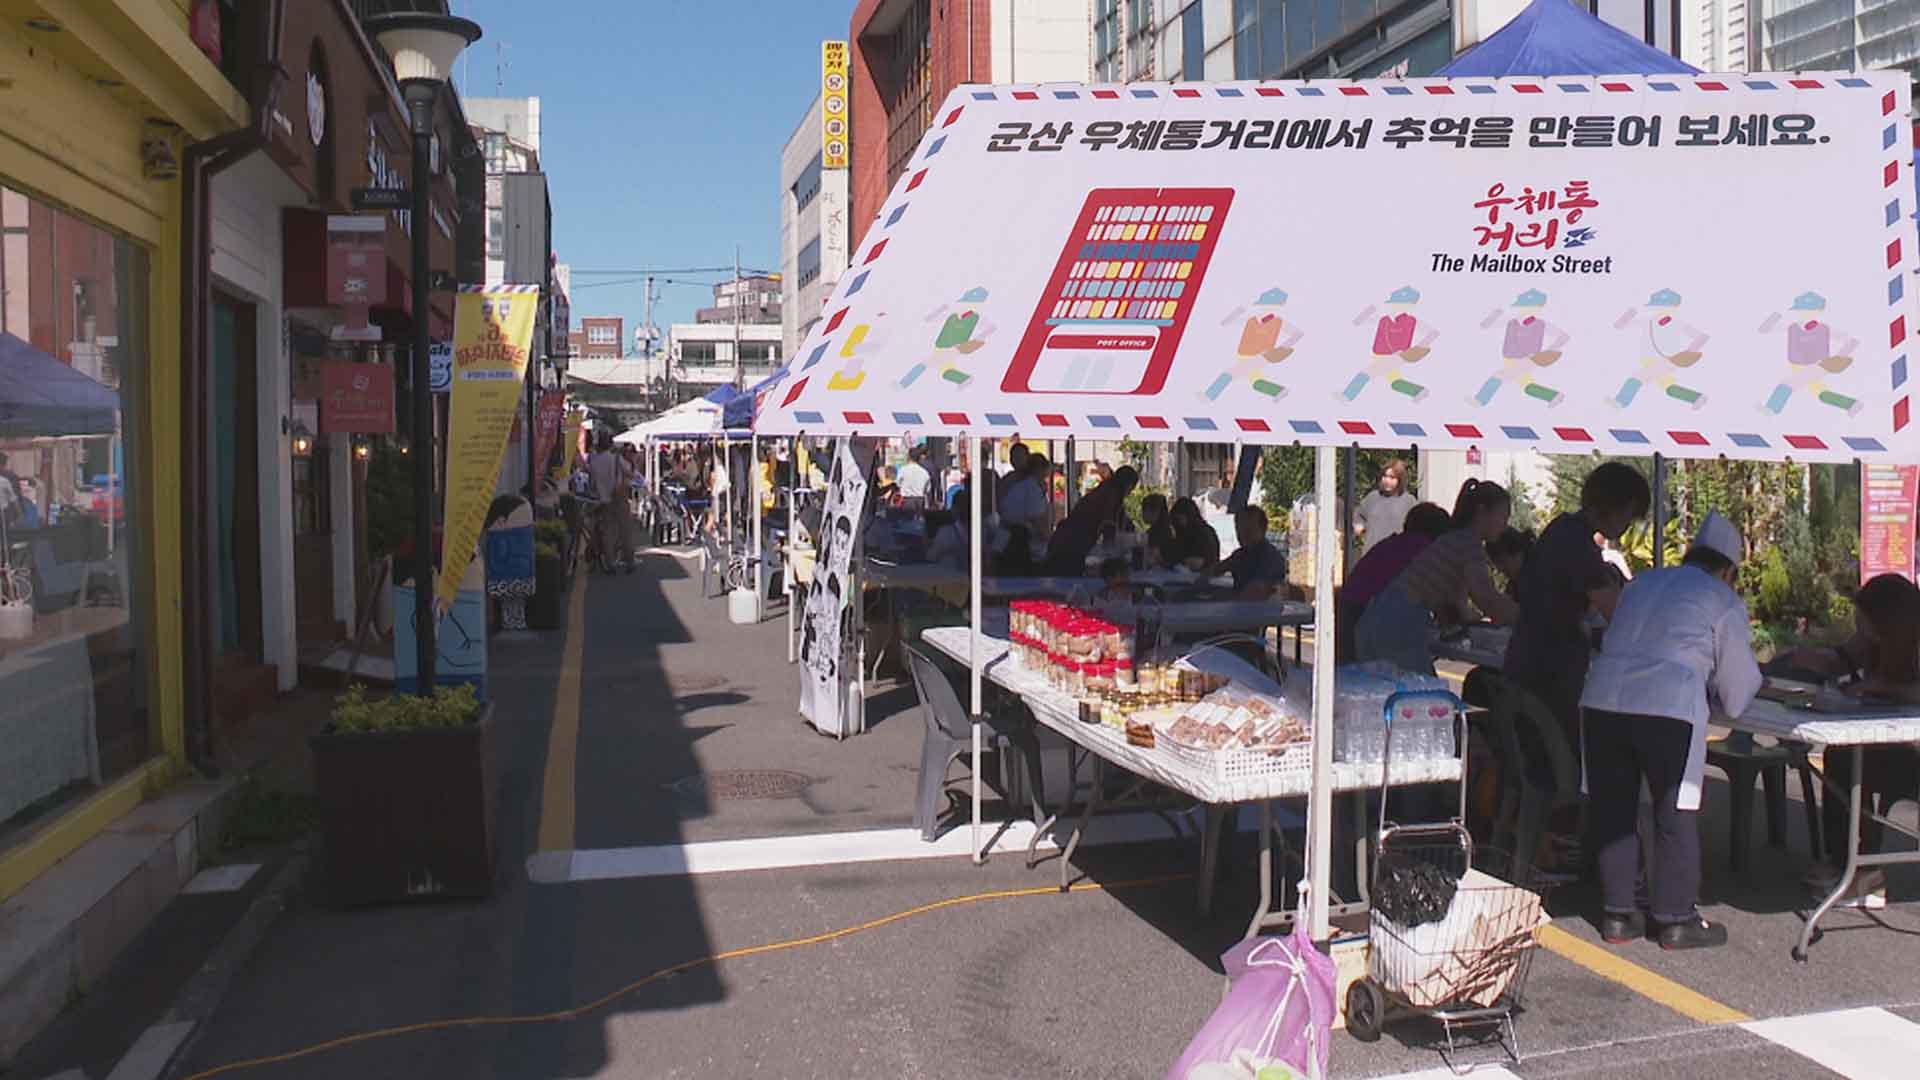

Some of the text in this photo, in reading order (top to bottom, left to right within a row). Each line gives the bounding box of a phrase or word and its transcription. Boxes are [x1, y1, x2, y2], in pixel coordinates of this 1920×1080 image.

[986, 114, 1831, 152] 군산 우체통거리에서 추억을 만들어 보세요.
[1474, 180, 1599, 226] 우체통
[1472, 218, 1559, 252] 거리
[1431, 253, 1612, 274] The Mailbox Street
[1096, 339, 1147, 347] POST OFFICE
